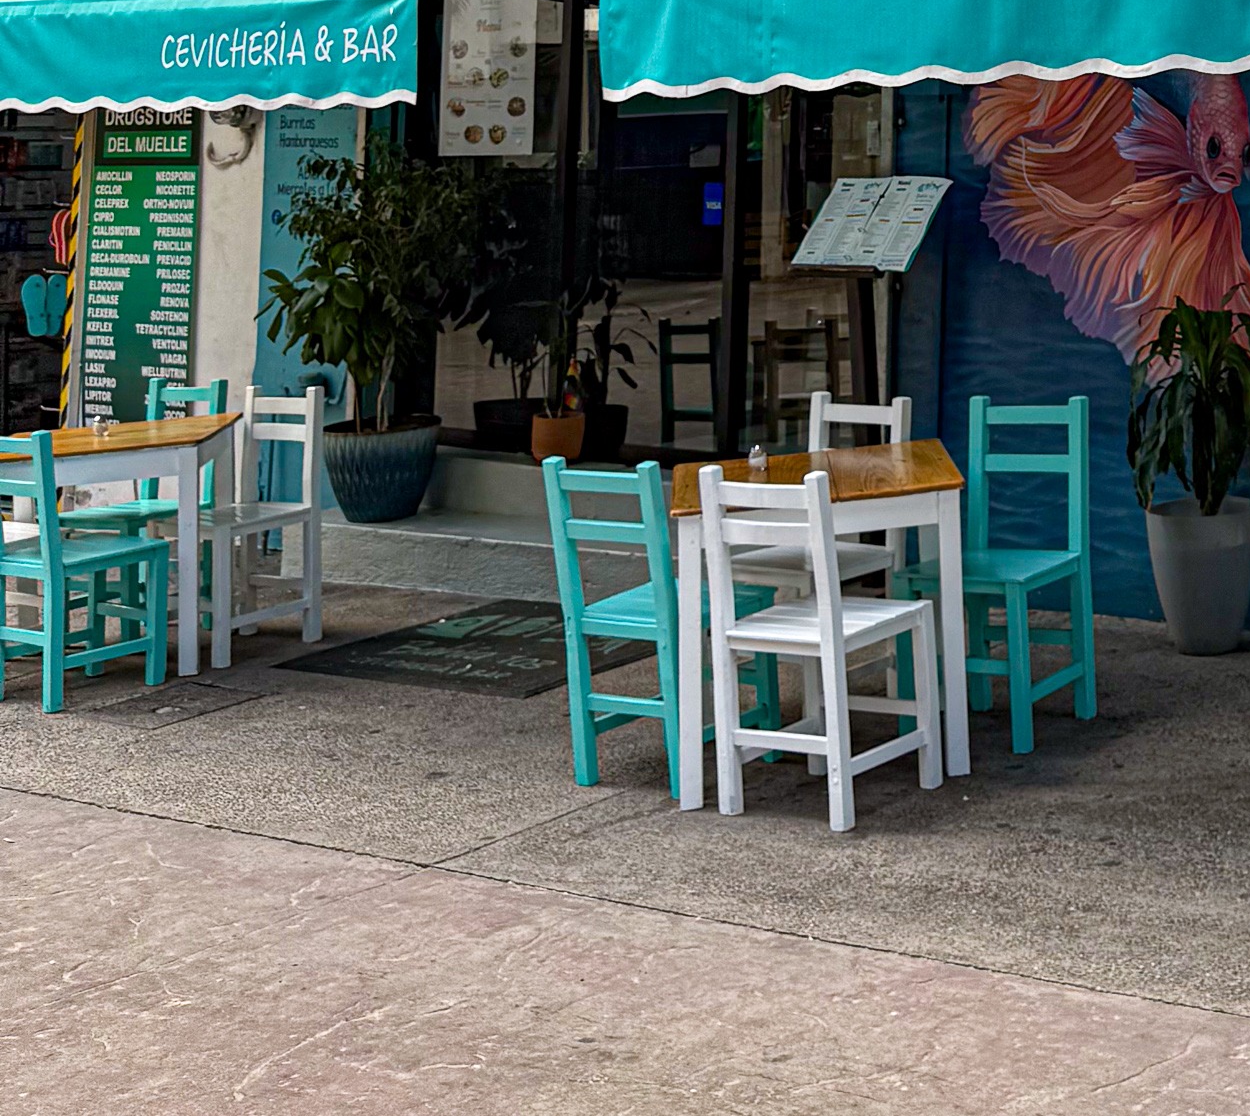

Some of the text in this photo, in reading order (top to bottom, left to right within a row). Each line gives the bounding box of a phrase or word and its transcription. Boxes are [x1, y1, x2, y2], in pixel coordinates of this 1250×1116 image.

[161, 20, 399, 69] CEVICHERÍA & BAR
[107, 135, 188, 153] DEL MUELLE
[161, 282, 191, 294] PROZAC
[160, 353, 188, 365] VIAGRA
[84, 362, 106, 374] LASIX
